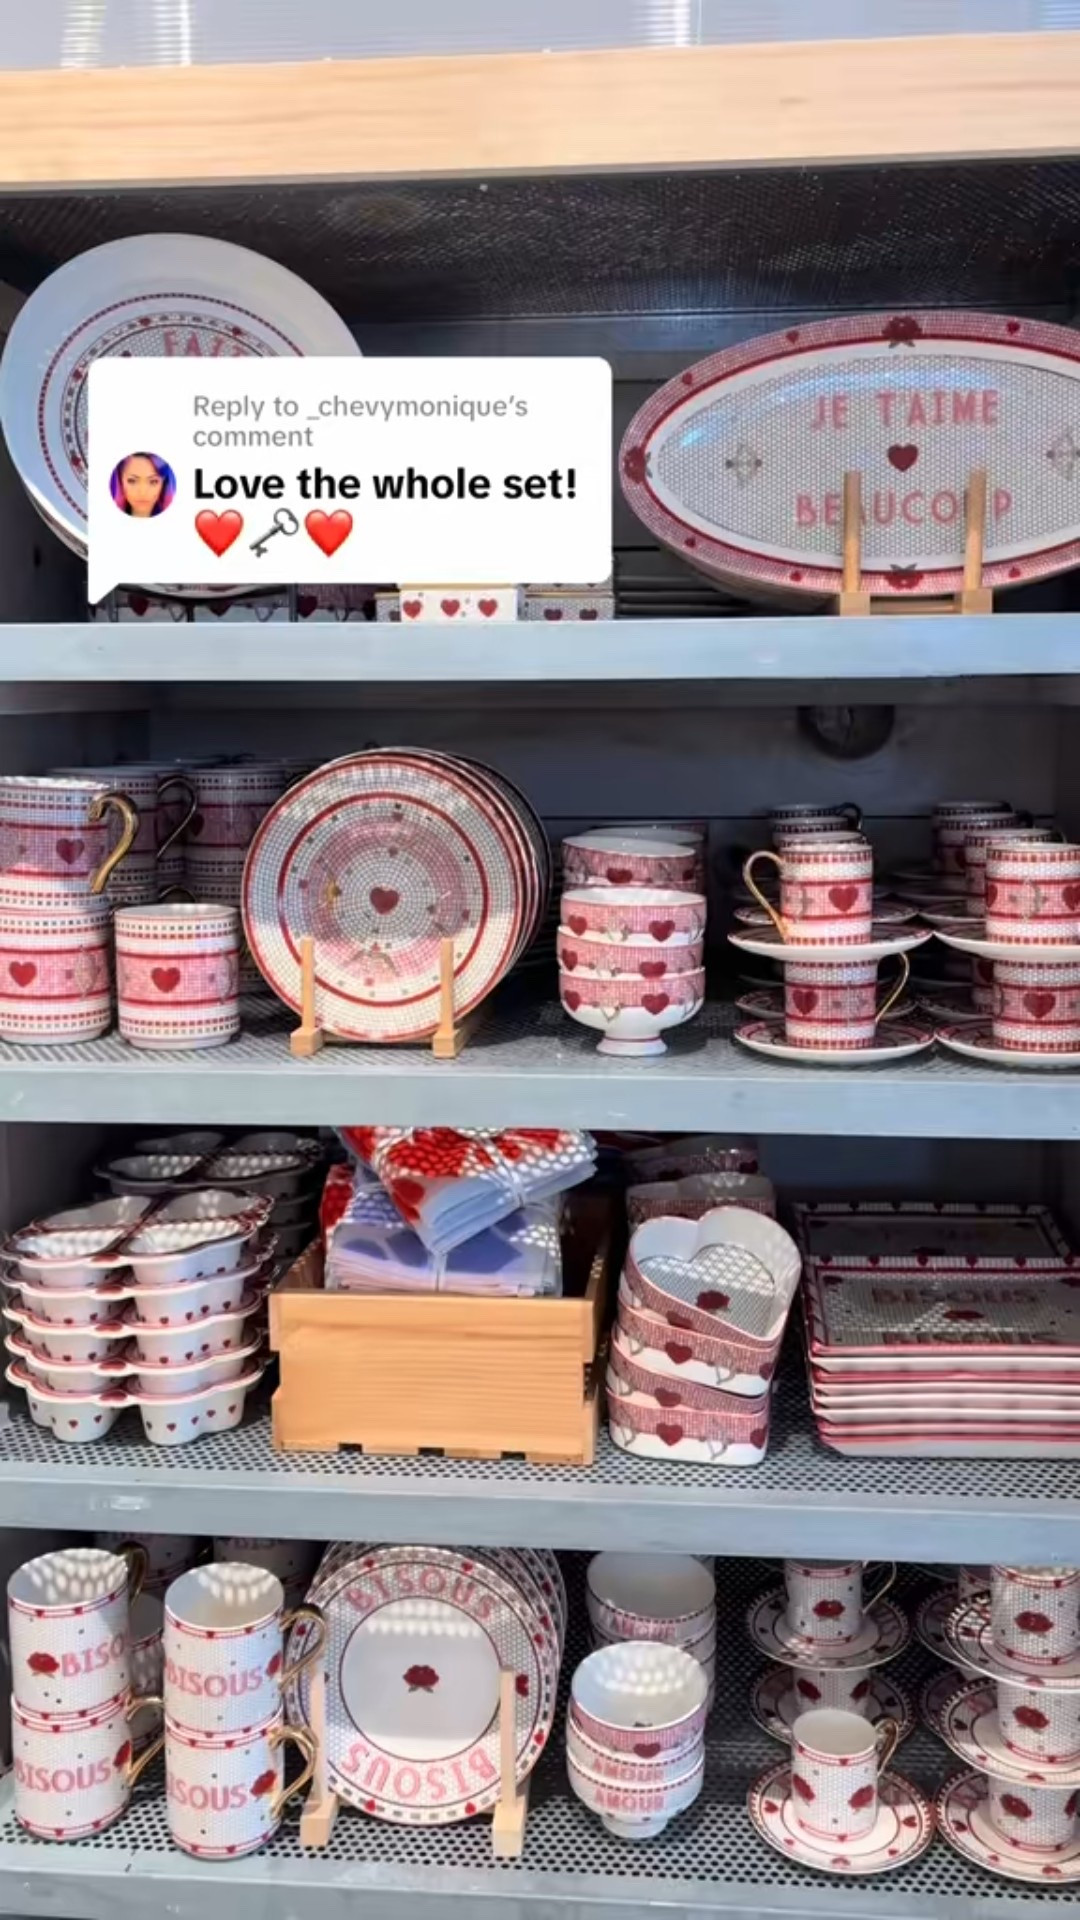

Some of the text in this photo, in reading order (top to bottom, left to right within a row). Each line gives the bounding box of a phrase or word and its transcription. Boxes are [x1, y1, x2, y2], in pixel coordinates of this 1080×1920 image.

[811, 394, 849, 431] JE
[795, 488, 1013, 526] BEUCOP
[345, 1565, 497, 1620] BISOUS
[164, 1657, 264, 1698] BISOUS
[14, 1756, 112, 1793] BISOUS
[340, 1742, 499, 1801] BISOUS
[591, 1757, 665, 1783] AMOUR
[593, 1788, 665, 1811] AMOUR
